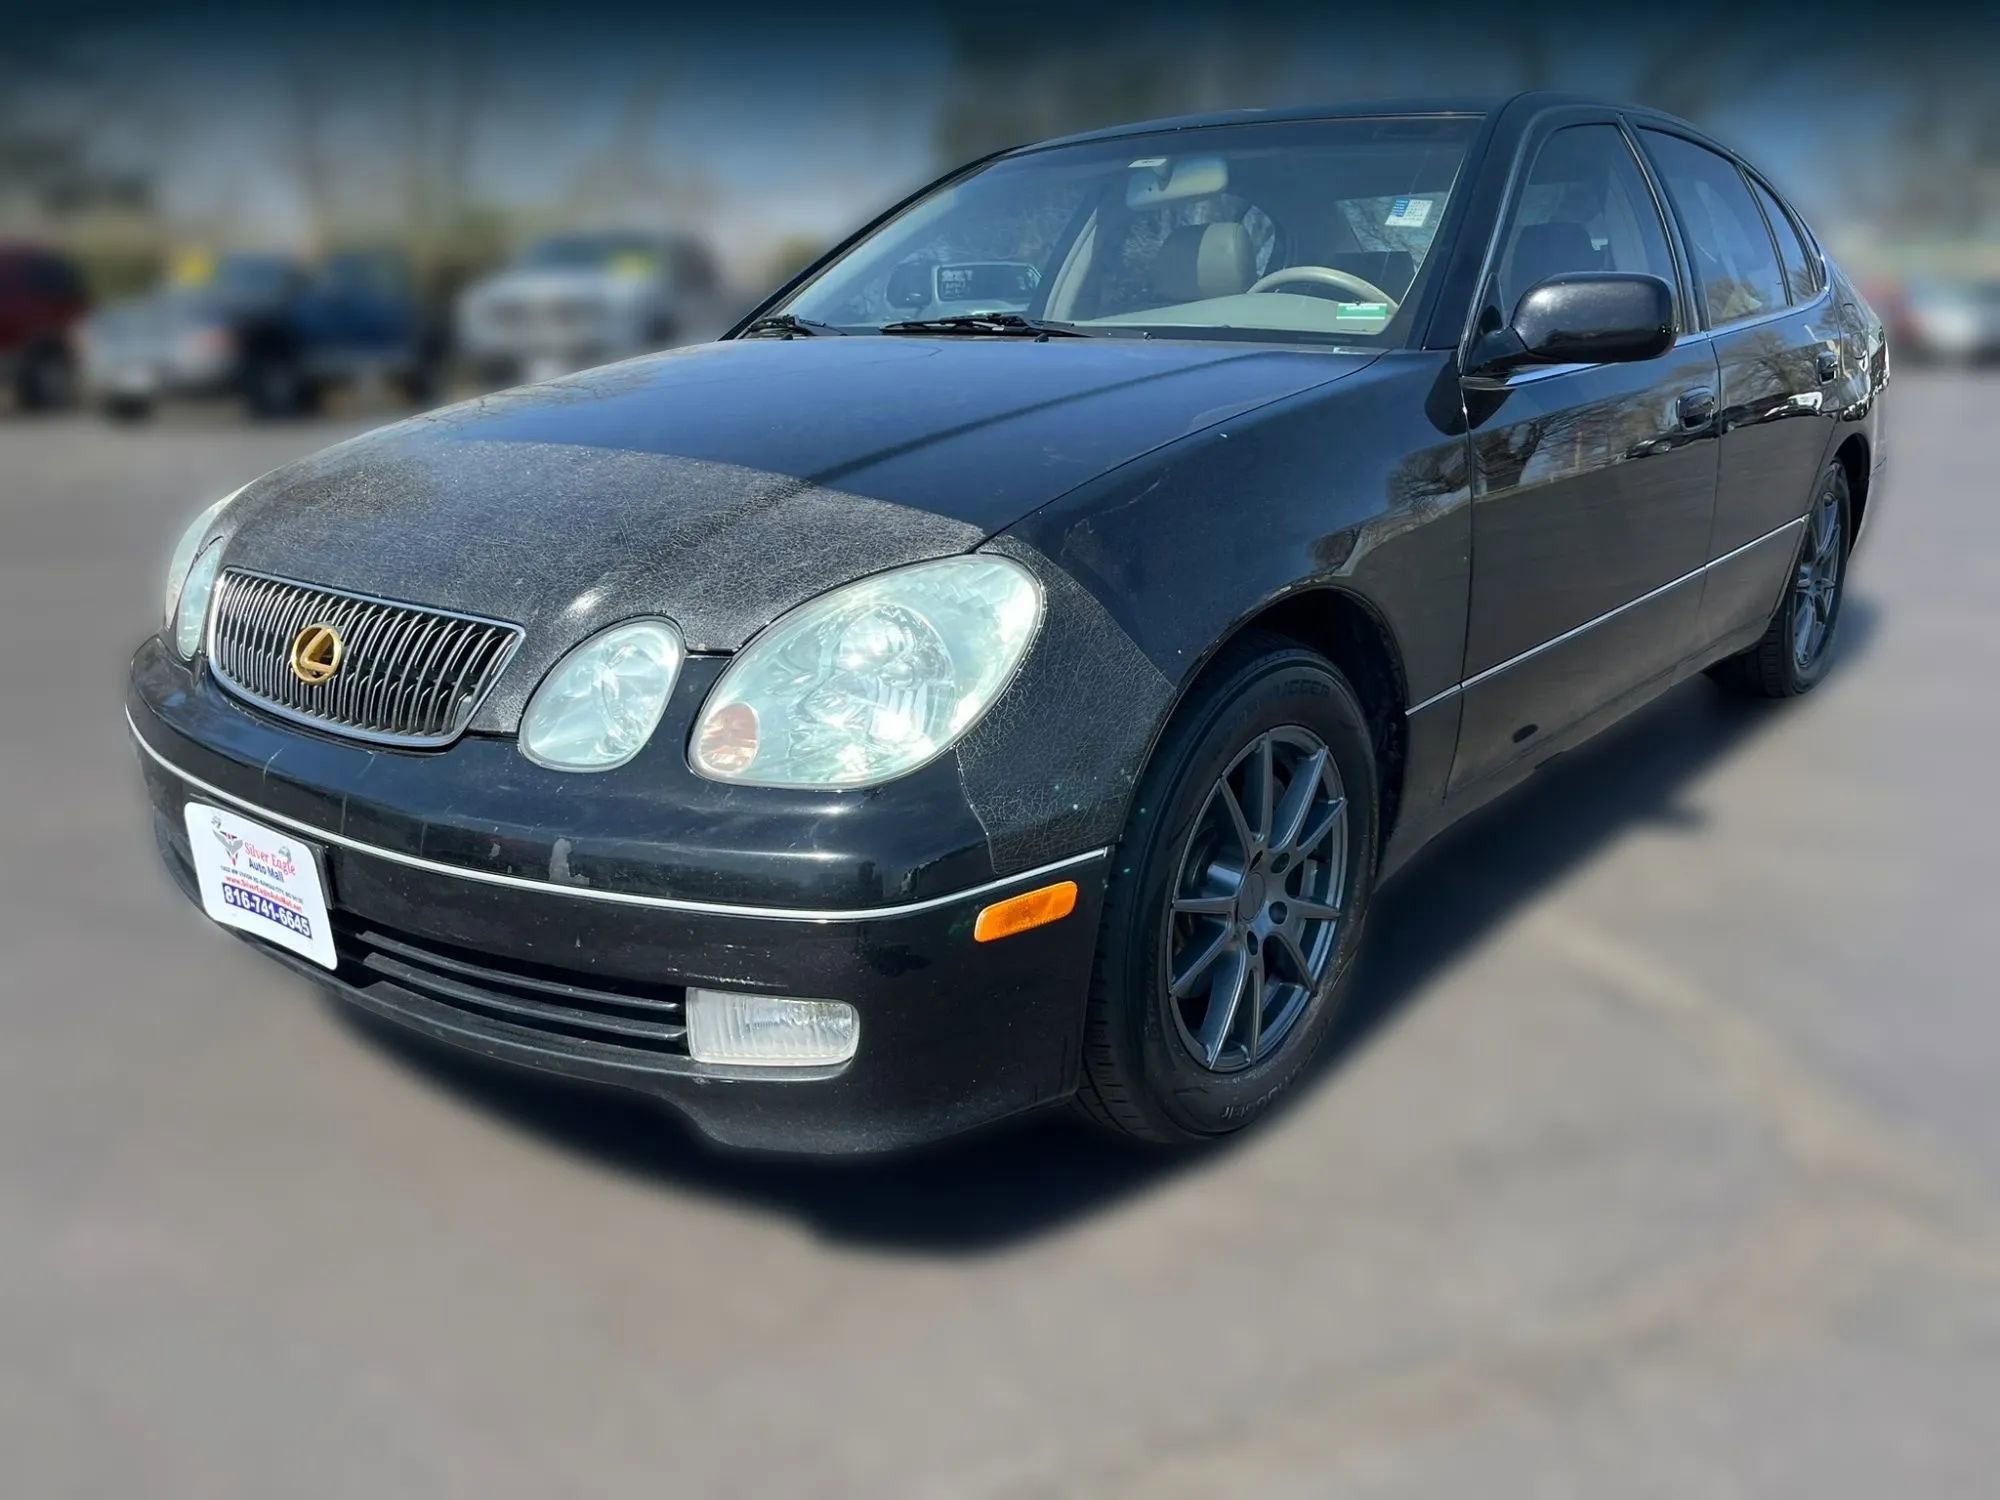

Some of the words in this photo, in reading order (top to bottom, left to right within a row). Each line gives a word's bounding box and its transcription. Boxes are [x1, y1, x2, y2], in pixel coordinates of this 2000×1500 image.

[245, 841, 269, 863] Silver
[271, 853, 296, 876] Eagle
[249, 857, 266, 875] Auto
[267, 866, 285, 882] Mall
[224, 885, 311, 937] 816-741-6645
